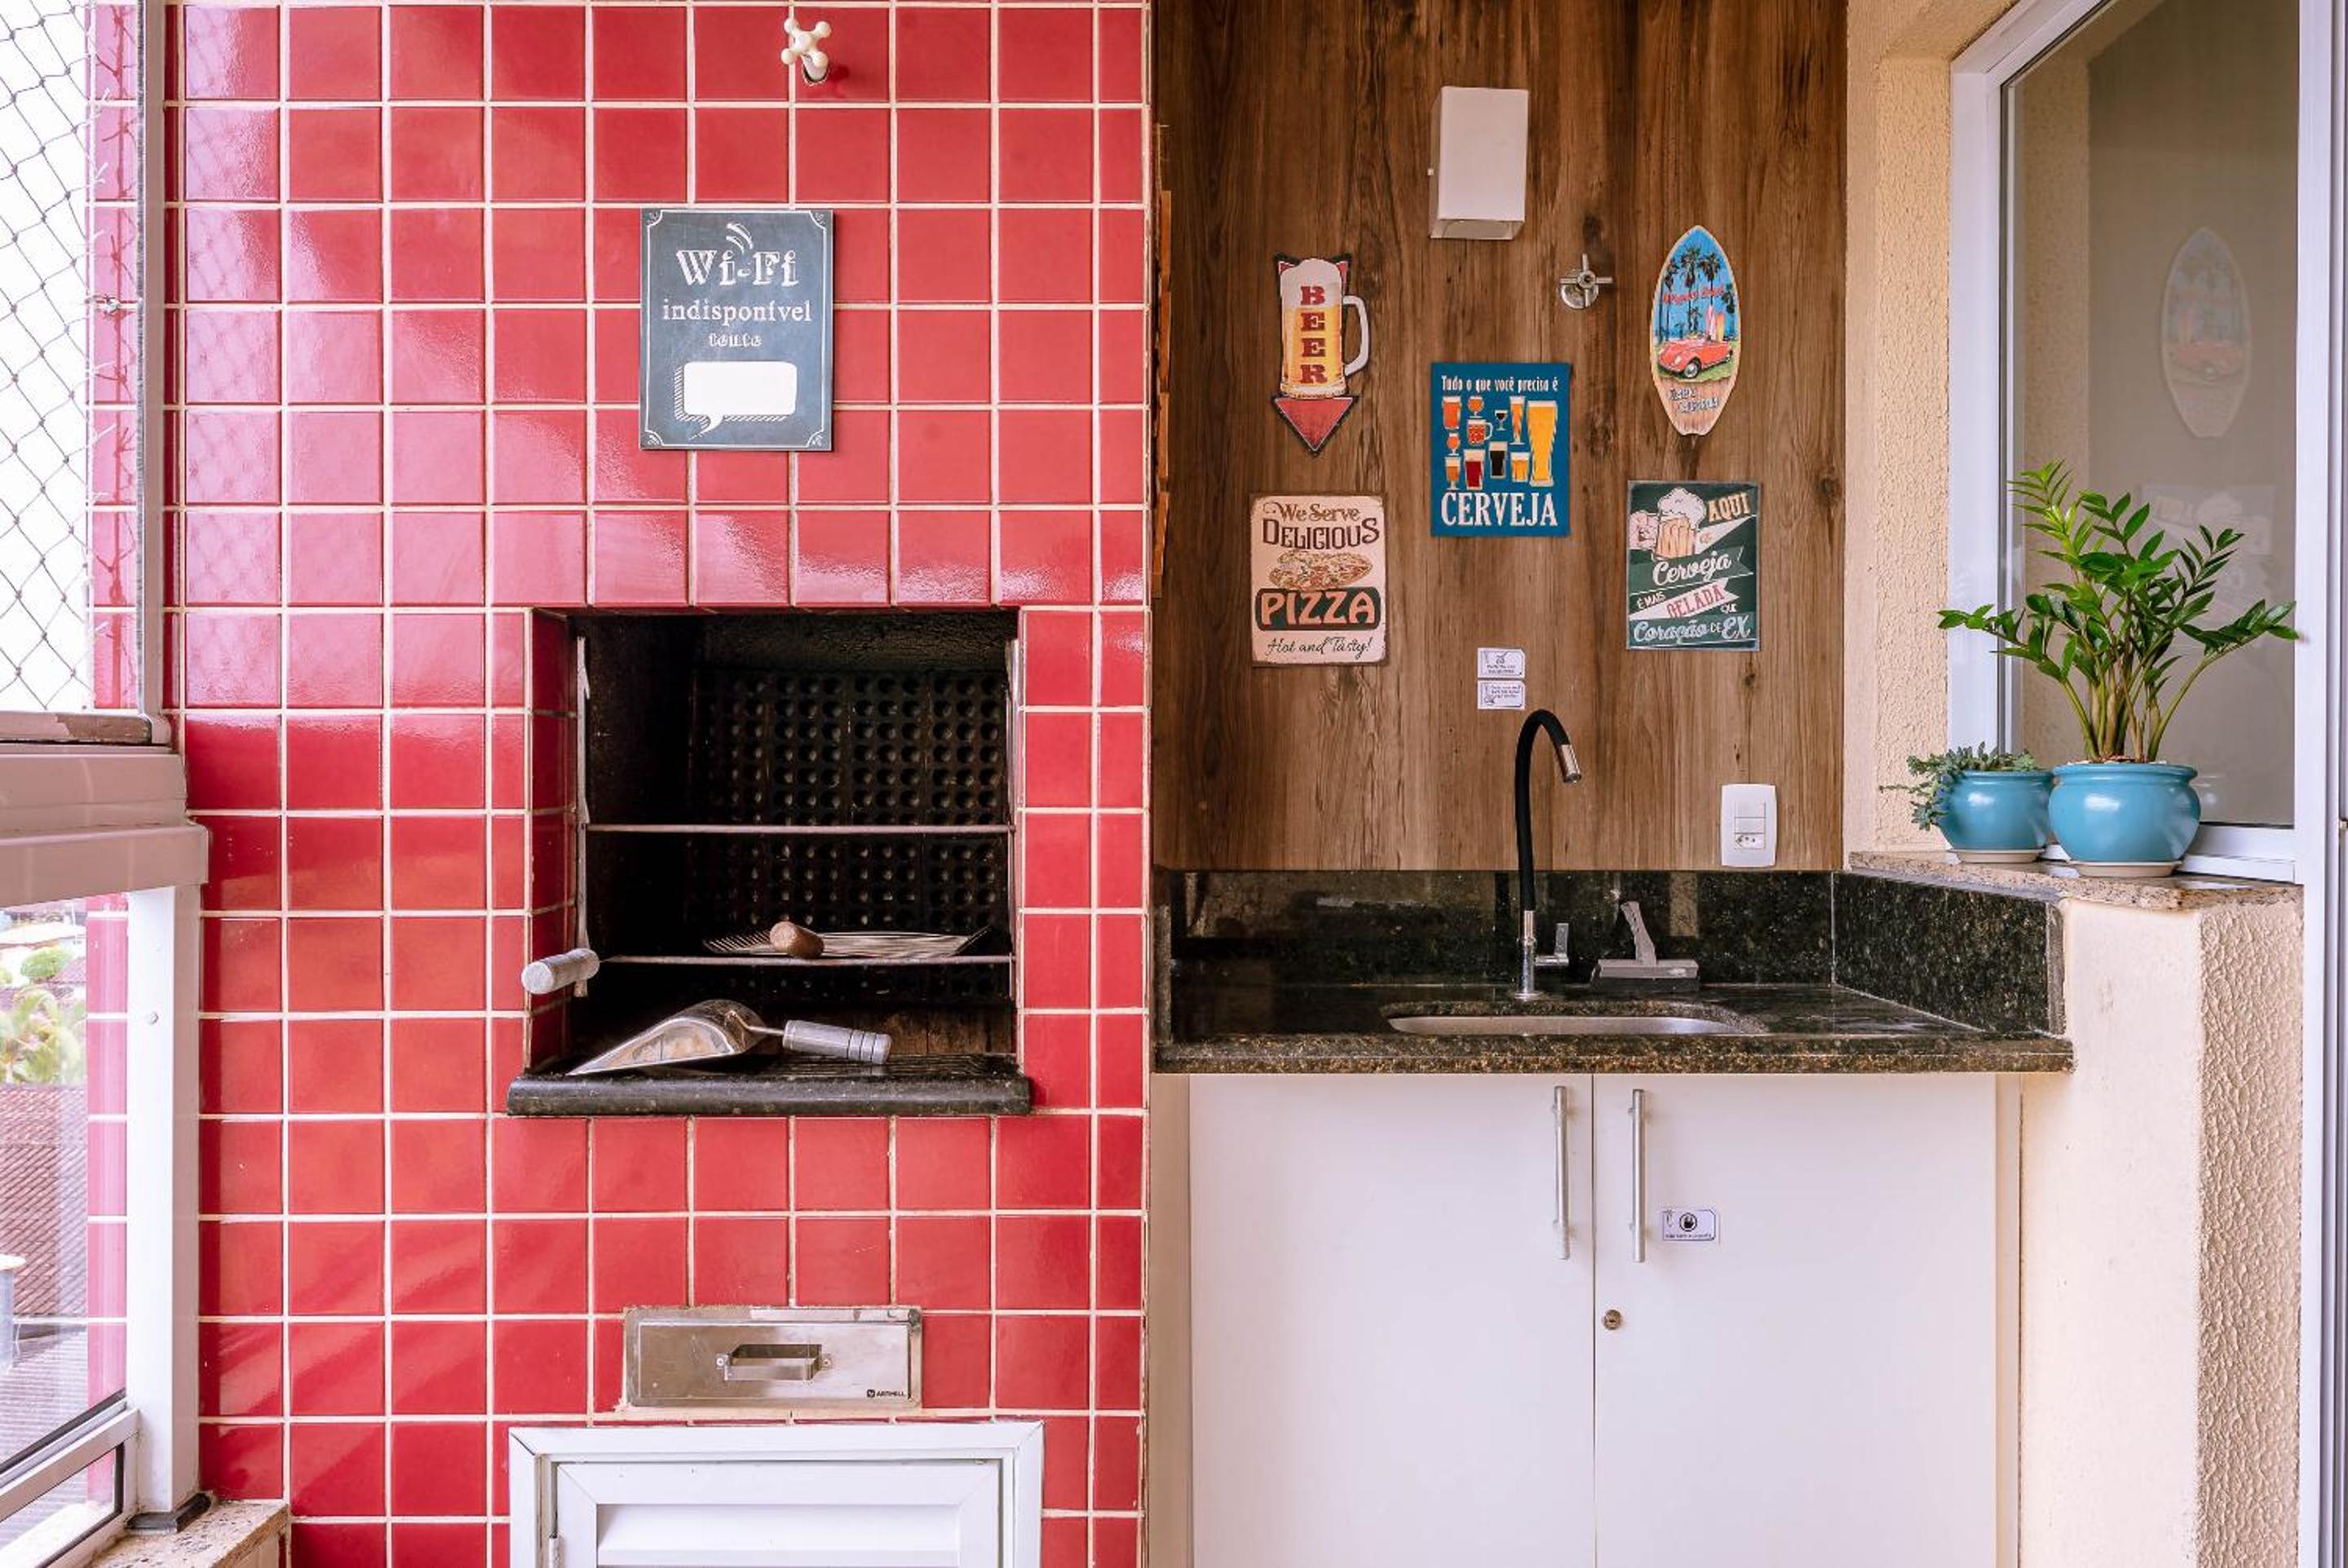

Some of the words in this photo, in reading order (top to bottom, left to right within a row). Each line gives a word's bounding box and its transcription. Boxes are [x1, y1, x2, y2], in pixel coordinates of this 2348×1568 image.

[675, 249, 799, 286] Wi-Fi
[662, 298, 812, 326] indisponível
[1299, 285, 1328, 385] BEER
[1441, 374, 1463, 391] Tudo
[1466, 378, 1472, 391] o
[1475, 378, 1492, 393] que
[1494, 376, 1514, 392] você
[1517, 376, 1550, 393] precisa
[1552, 376, 1559, 391] é
[1263, 501, 1307, 522] We
[1308, 503, 1362, 522] Serve
[1441, 491, 1559, 527] CERVEJA
[1708, 492, 1750, 523] AQUI
[1262, 517, 1381, 550] DELICIOUS
[1652, 550, 1732, 585] Cerveja
[1261, 590, 1375, 626] PIZZA
[1266, 638, 1296, 656] Hot
[1298, 638, 1329, 655] and
[1634, 619, 1709, 645] Coração
